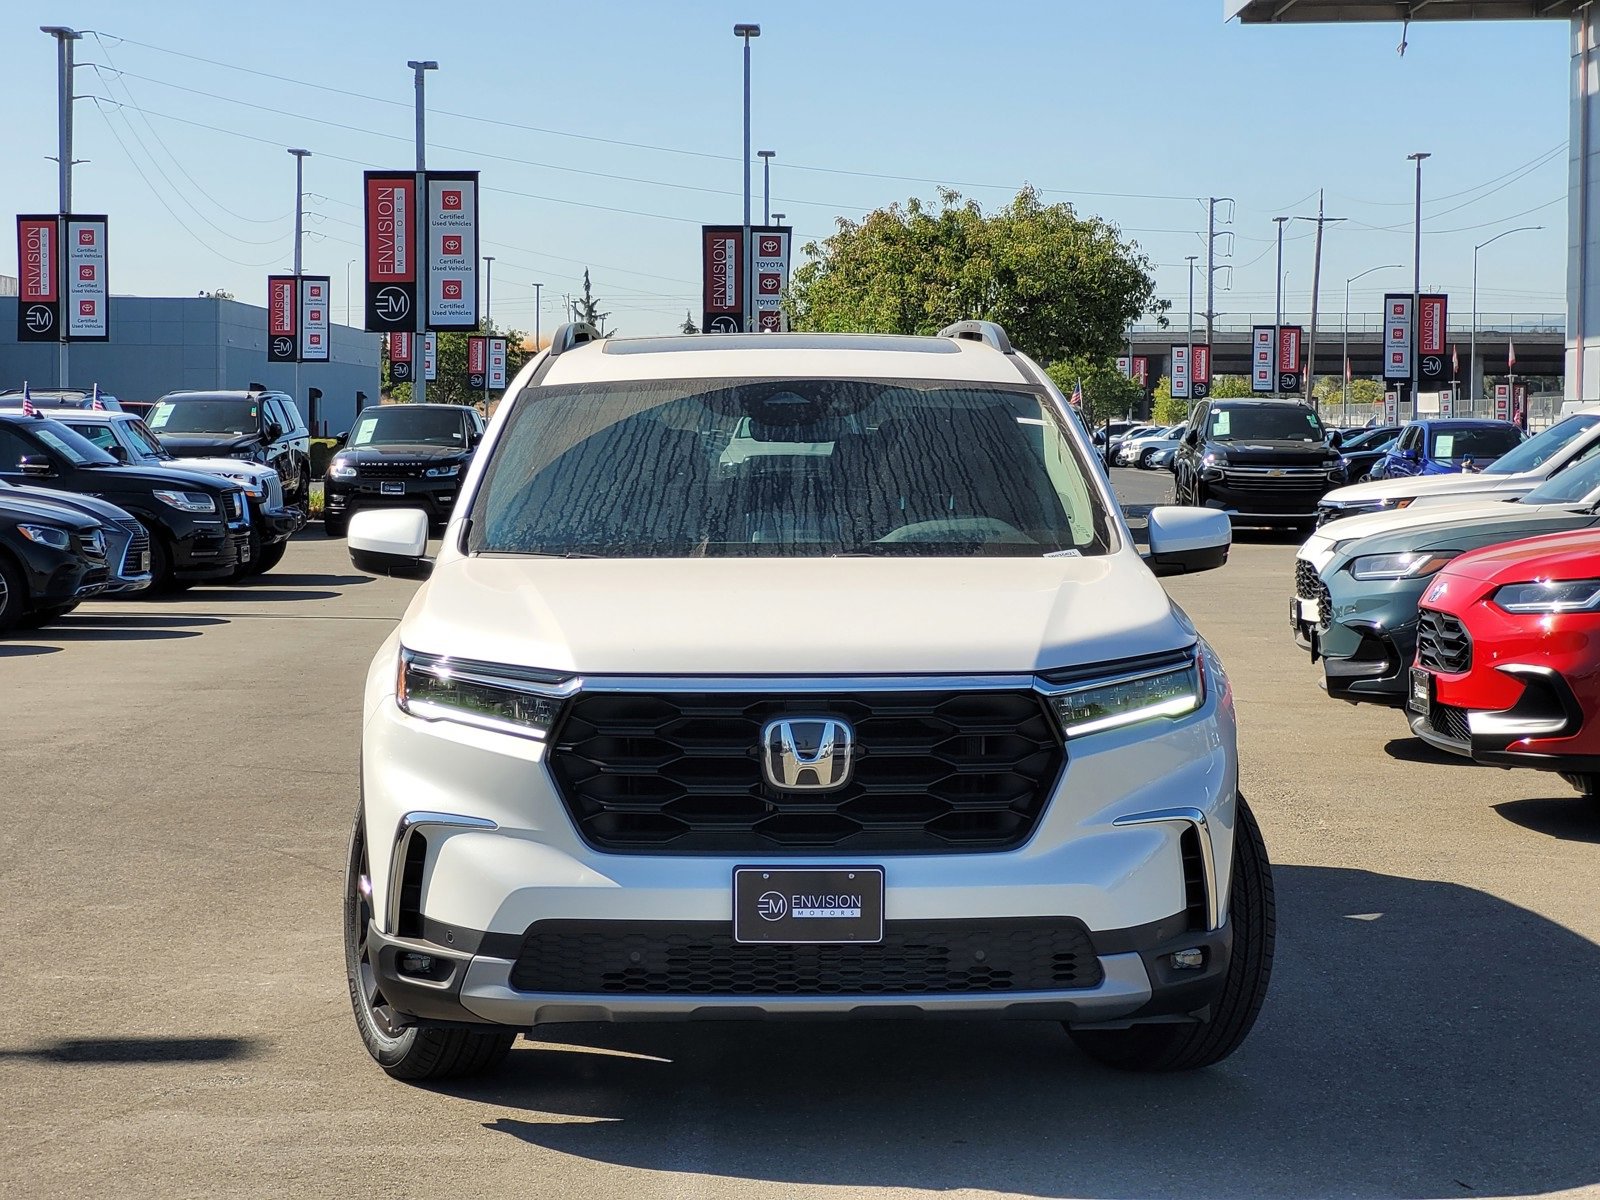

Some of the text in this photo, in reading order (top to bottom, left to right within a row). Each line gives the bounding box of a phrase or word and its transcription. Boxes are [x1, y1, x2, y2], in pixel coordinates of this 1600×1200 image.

[378, 187, 393, 274] ENVISION
[27, 227, 40, 296] ENVISION
[713, 239, 725, 306] ENVISION
[275, 284, 284, 331] ENVISION
[1424, 302, 1434, 350] ENVISION
[792, 895, 861, 908] ENVISION
